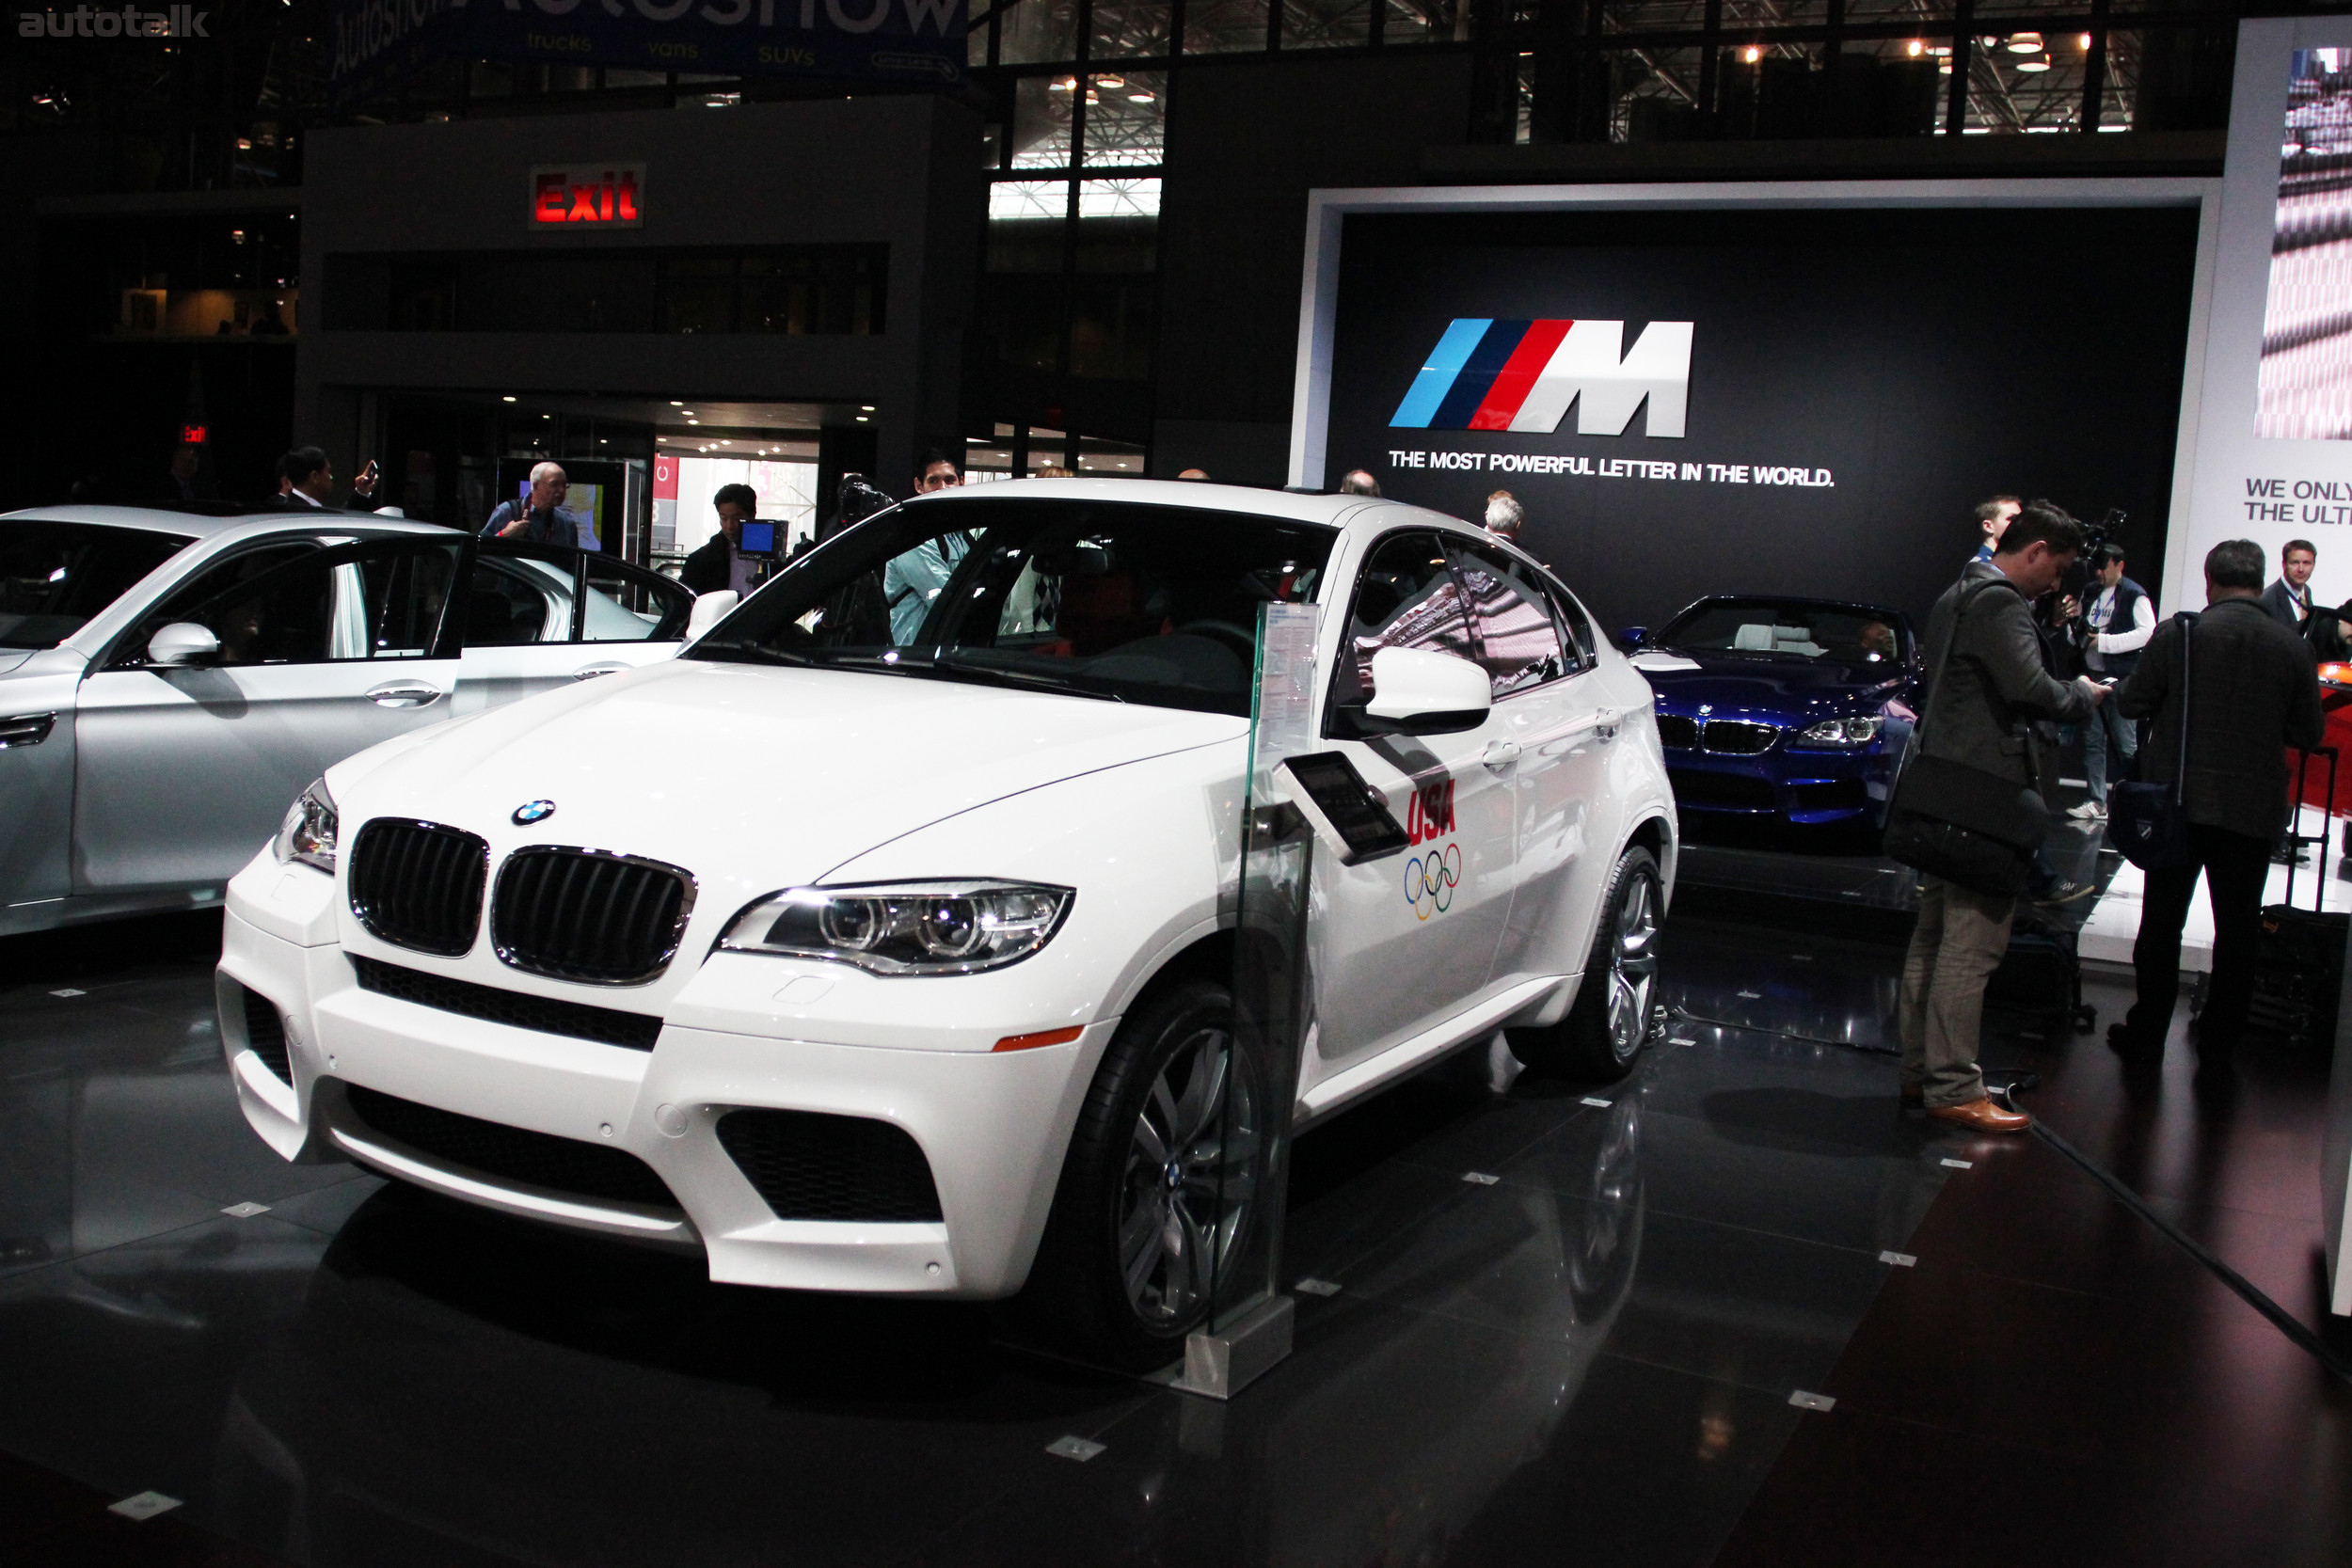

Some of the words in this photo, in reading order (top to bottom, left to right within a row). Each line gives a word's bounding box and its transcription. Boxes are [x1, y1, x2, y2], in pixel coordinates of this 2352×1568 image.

[527, 32, 593, 53] trucks
[648, 42, 699, 60] vans
[758, 45, 815, 67] SUVs
[535, 171, 637, 222] Exit
[1389, 450, 1425, 468] THE
[1430, 451, 1486, 470] MOST
[1489, 453, 1595, 476] POWERFUL
[1599, 458, 1677, 481] LETTER
[1680, 462, 1702, 482] IN
[1707, 464, 1749, 483] THE
[1754, 466, 1835, 487] WORLD.
[2246, 478, 2286, 499] WE
[2243, 501, 2295, 522] THE
[1407, 778, 1455, 847] USA
